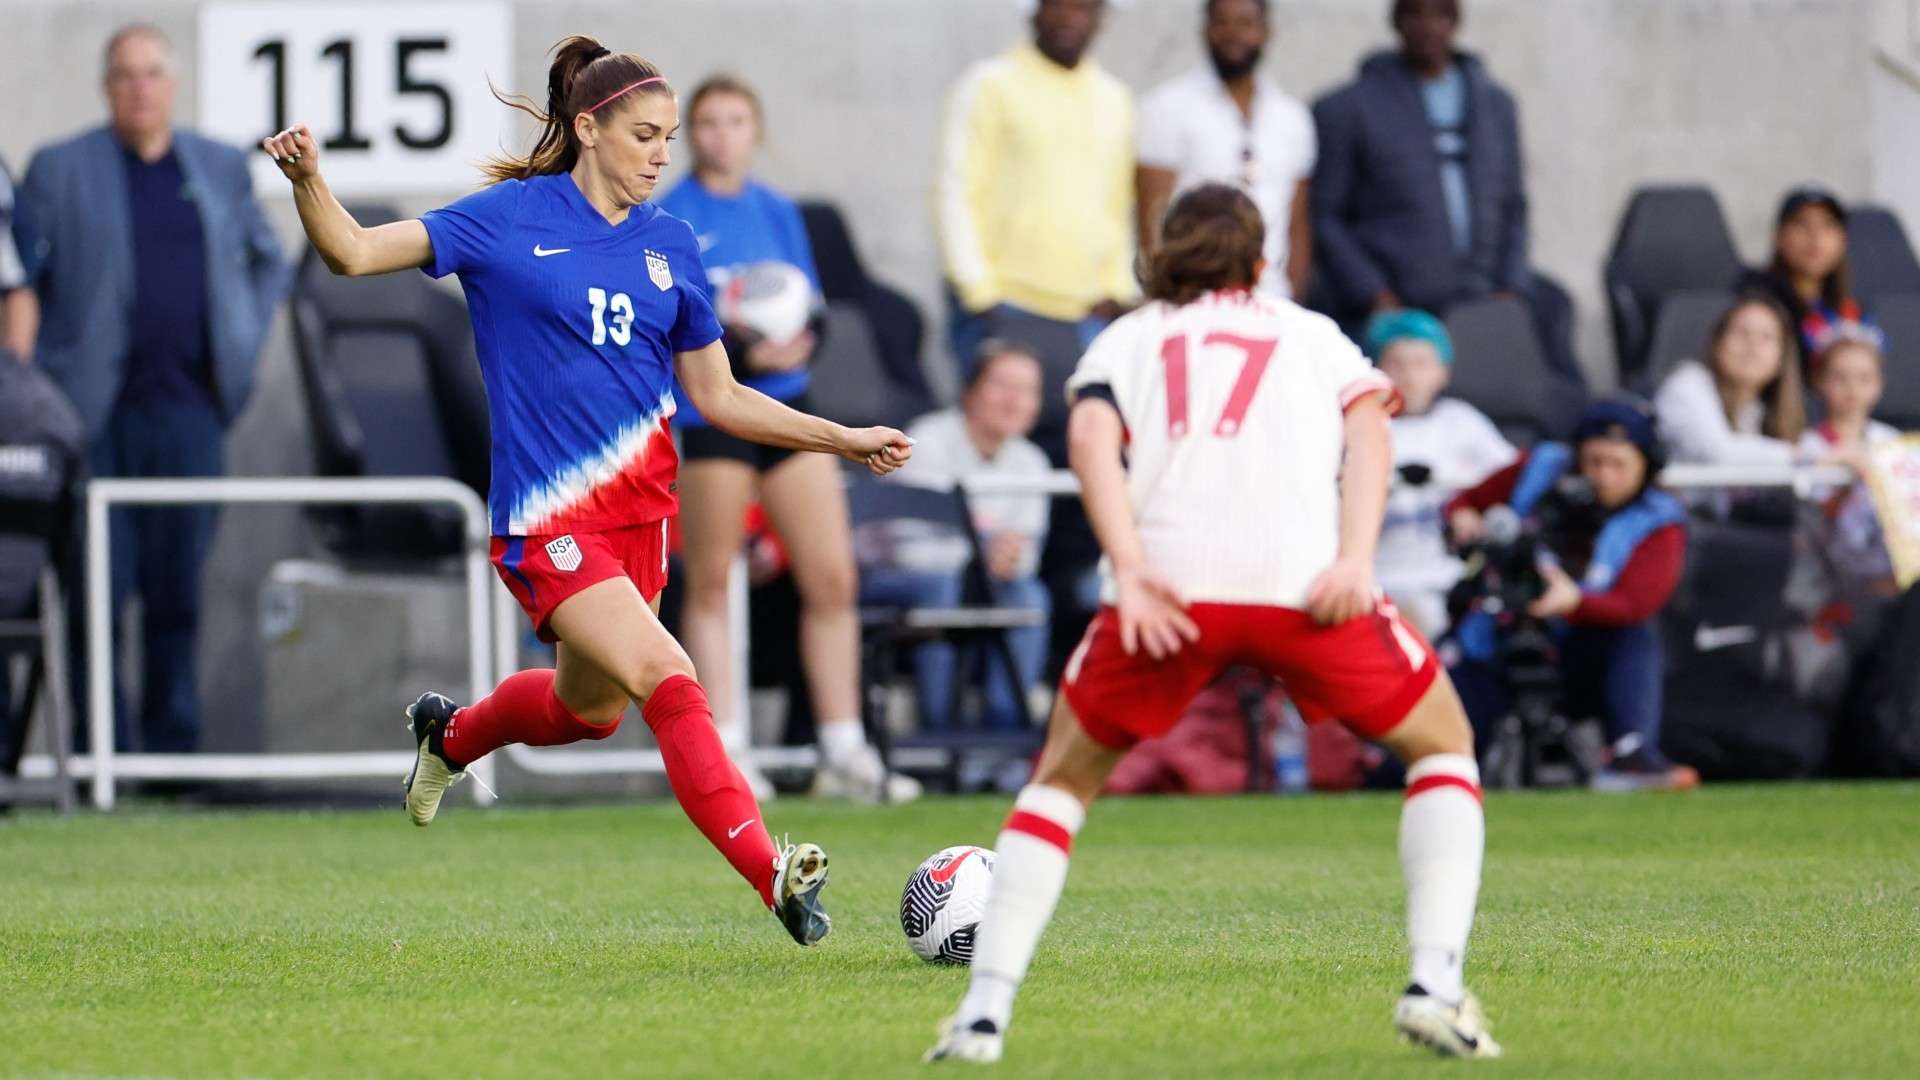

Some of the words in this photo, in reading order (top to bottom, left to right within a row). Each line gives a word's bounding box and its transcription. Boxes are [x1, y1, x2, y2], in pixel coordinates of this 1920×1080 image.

[250, 38, 457, 150] 115
[647, 257, 668, 272] USA
[588, 287, 635, 347] 13
[1160, 332, 1280, 438] 17
[547, 536, 573, 554] USA
